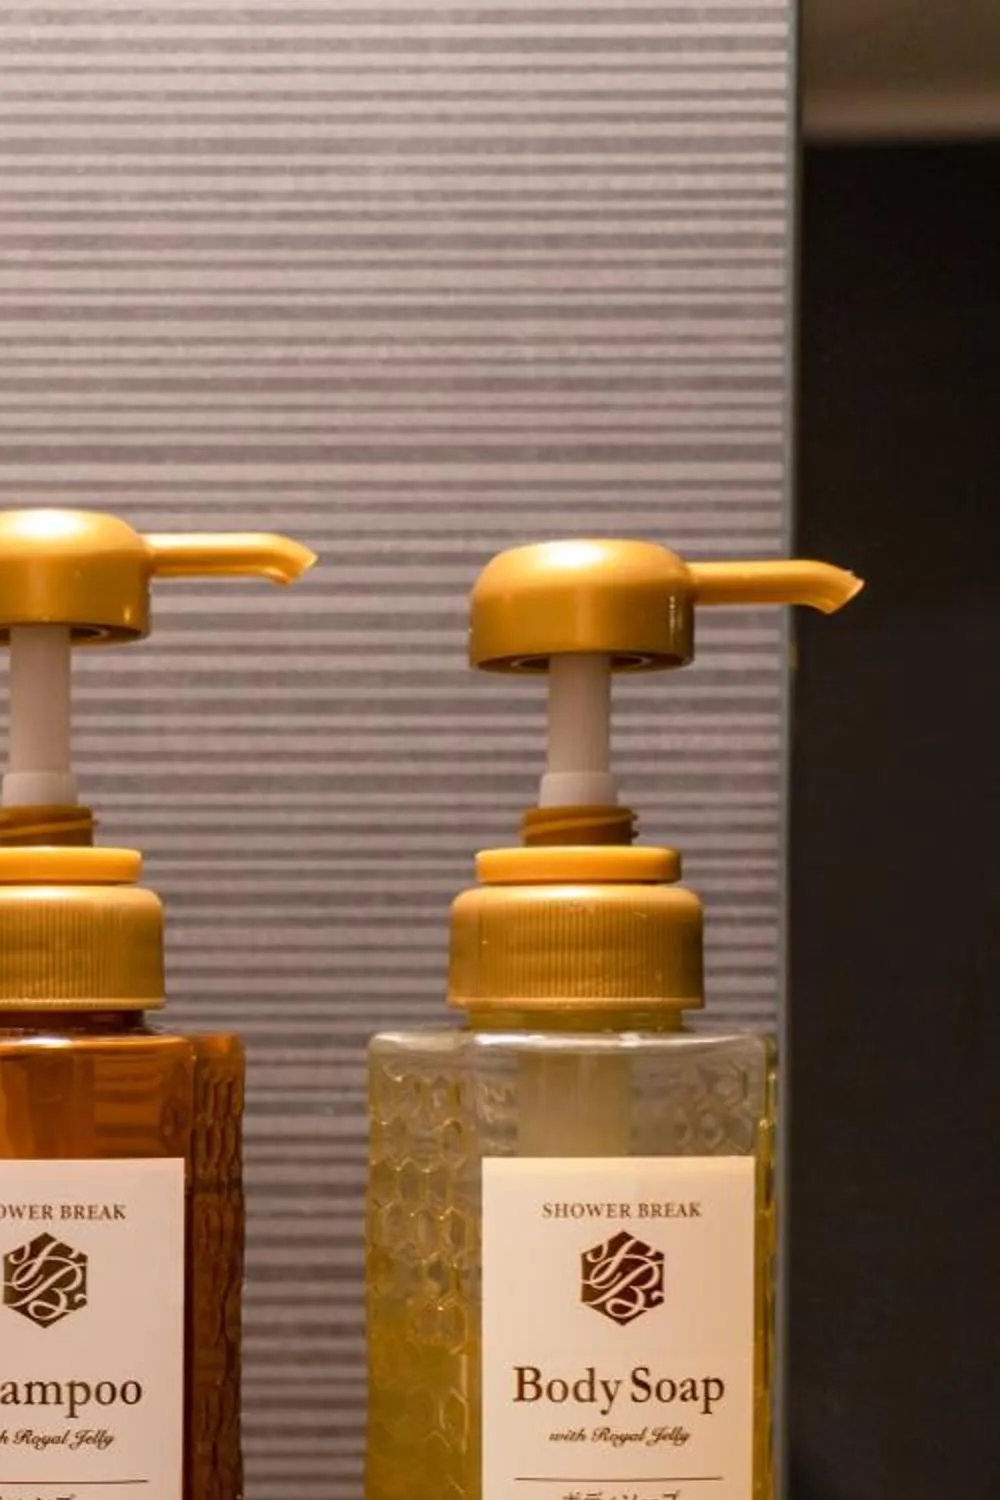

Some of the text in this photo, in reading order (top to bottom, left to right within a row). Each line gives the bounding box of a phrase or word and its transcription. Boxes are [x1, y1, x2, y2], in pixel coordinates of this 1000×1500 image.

[60, 1204, 126, 1221] BREAK
[542, 1202, 701, 1219] SHOWER BREAK
[513, 1366, 725, 1416] Body Soap
[12, 1427, 68, 1451] Royal
[69, 1429, 115, 1450] Jelly
[549, 1425, 691, 1448] with Royal Jelly
